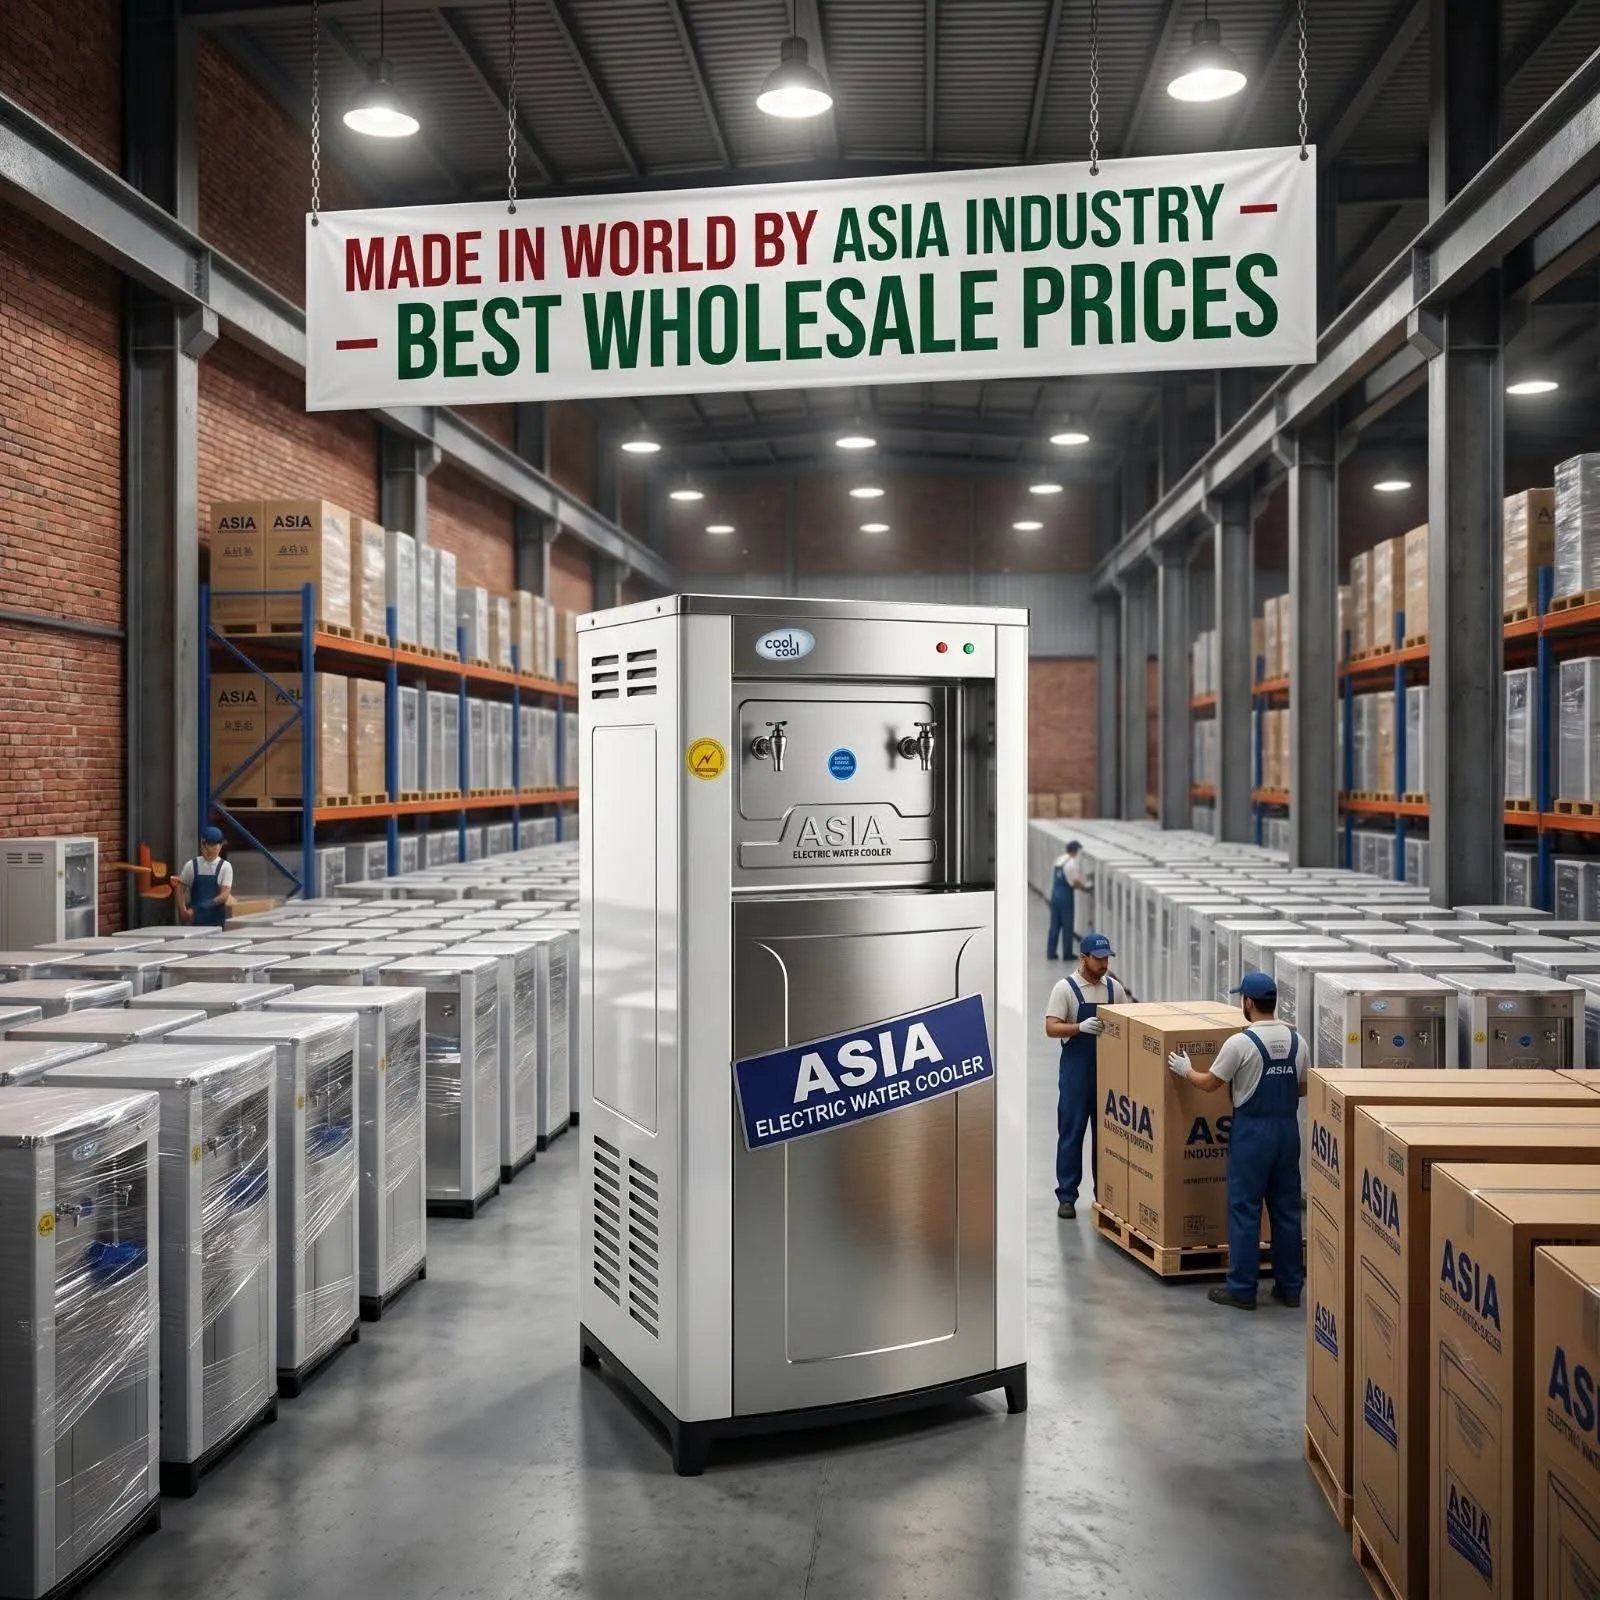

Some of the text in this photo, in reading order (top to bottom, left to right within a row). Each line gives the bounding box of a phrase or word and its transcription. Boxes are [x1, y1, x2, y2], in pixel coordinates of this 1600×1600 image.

[345, 231, 481, 291] MADE
[499, 227, 545, 282] IN
[561, 215, 736, 278] WORLD
[755, 209, 818, 267] BY
[833, 202, 949, 263] ASIA
[966, 183, 1225, 255] INDUSTRY
[398, 294, 562, 380] BEST
[582, 269, 998, 370] WHOLESALE
[1023, 252, 1279, 349] PRICES
[219, 517, 256, 529] ASIA
[273, 515, 312, 528] ASIA
[765, 634, 793, 649] cool
[775, 641, 799, 657] cool
[218, 691, 257, 704] ASIA
[793, 847, 892, 859] ELECTRIC WATER COOLER
[796, 815, 888, 848] ASIA
[793, 1021, 944, 1104] ASIA
[755, 1055, 985, 1138] ELECTRIC WATER COOLER
[1105, 1088, 1154, 1141] ASIA
[1311, 1119, 1340, 1175] ASIA
[1361, 1167, 1401, 1237] ASIA
[1440, 1238, 1502, 1333] ASIA
[1314, 1301, 1338, 1342] ASIA
[1364, 1376, 1396, 1430] ASIA
[1448, 1483, 1492, 1551] ASIA
